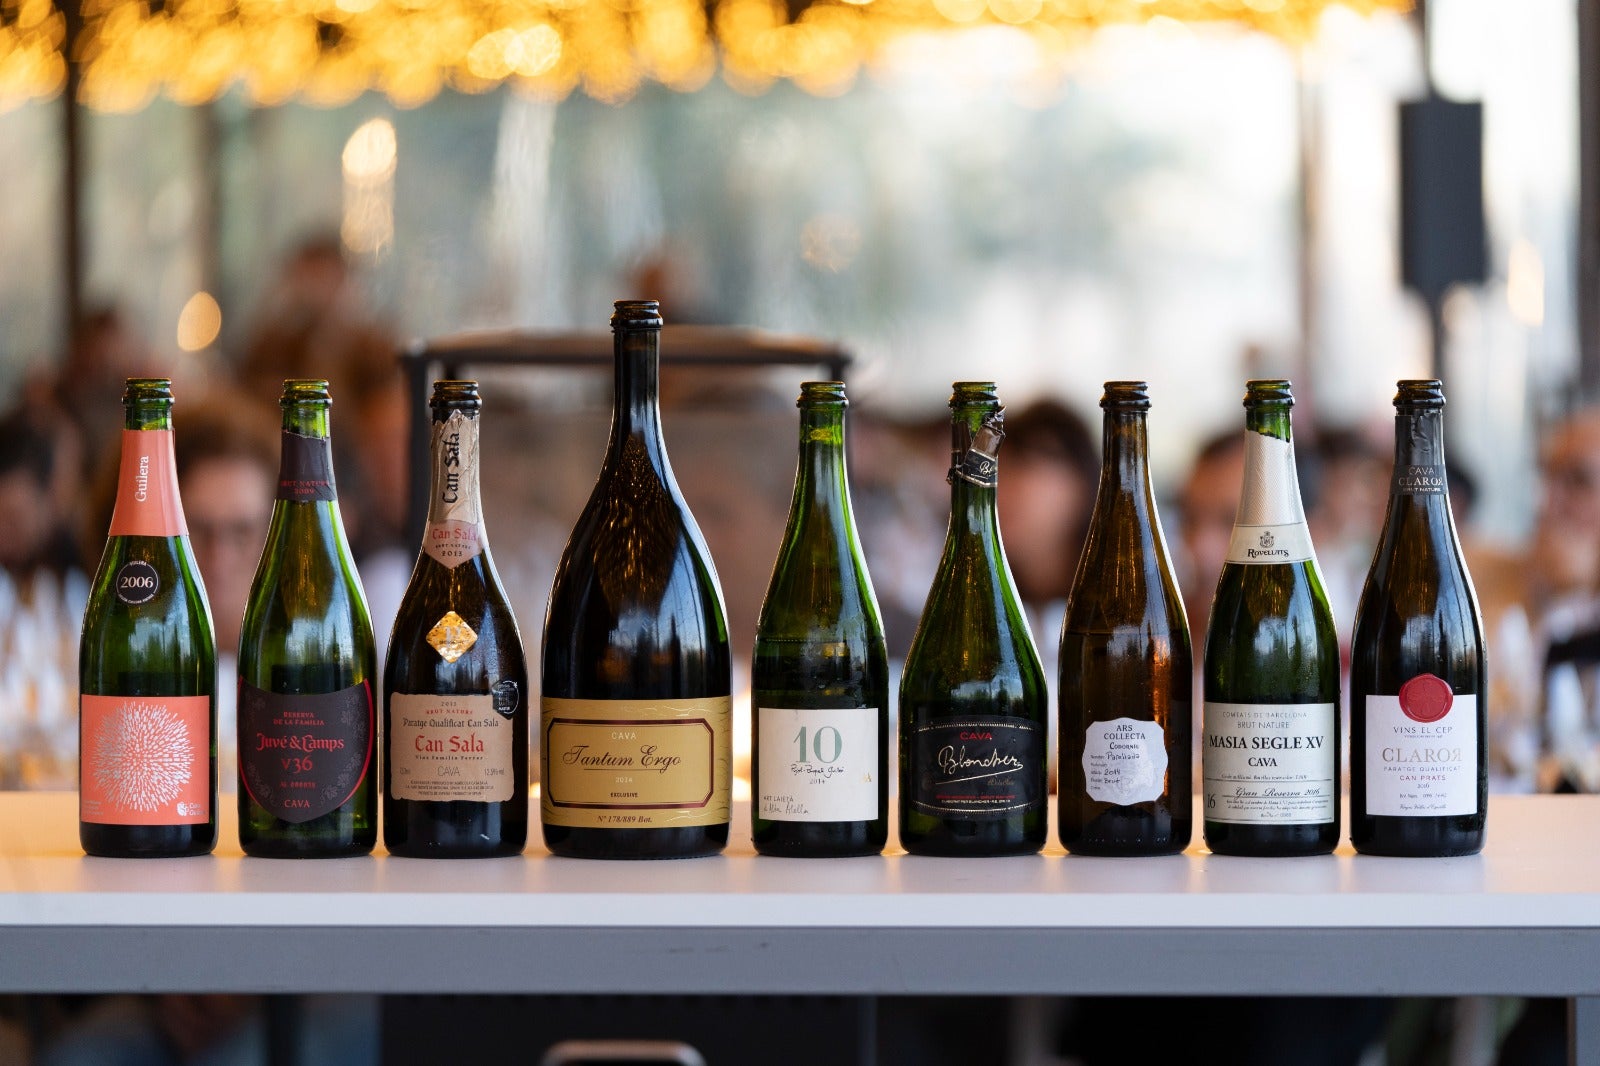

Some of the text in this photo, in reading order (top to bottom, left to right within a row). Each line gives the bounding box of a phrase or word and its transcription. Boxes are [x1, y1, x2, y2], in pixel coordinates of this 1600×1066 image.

[442, 433, 459, 504] Can Sala
[1409, 466, 1435, 475] CAVA
[135, 456, 149, 502] Guilera
[432, 527, 477, 541] Can Sala
[120, 576, 154, 588] 2006
[403, 717, 499, 729] Paratge Qualificat Can Sala
[1116, 724, 1133, 732] ARS
[1237, 721, 1290, 729] BRUT NATURE
[611, 731, 637, 740] CAVA
[960, 731, 992, 741] CAVA
[1393, 726, 1453, 734] VINS EL CEP
[415, 731, 484, 753] Can Sala
[793, 726, 842, 764] 10
[1209, 735, 1324, 750] MASIA SEGLE XV
[562, 744, 682, 774] Tantum Ergo
[1248, 757, 1277, 767] CAVA
[437, 765, 461, 777] CAVA
[1235, 786, 1258, 800] Gran
[1262, 787, 1301, 797] Reserva
[284, 799, 311, 808] CAVA
[1207, 793, 1216, 809] 16
[608, 815, 636, 824] 178/889
